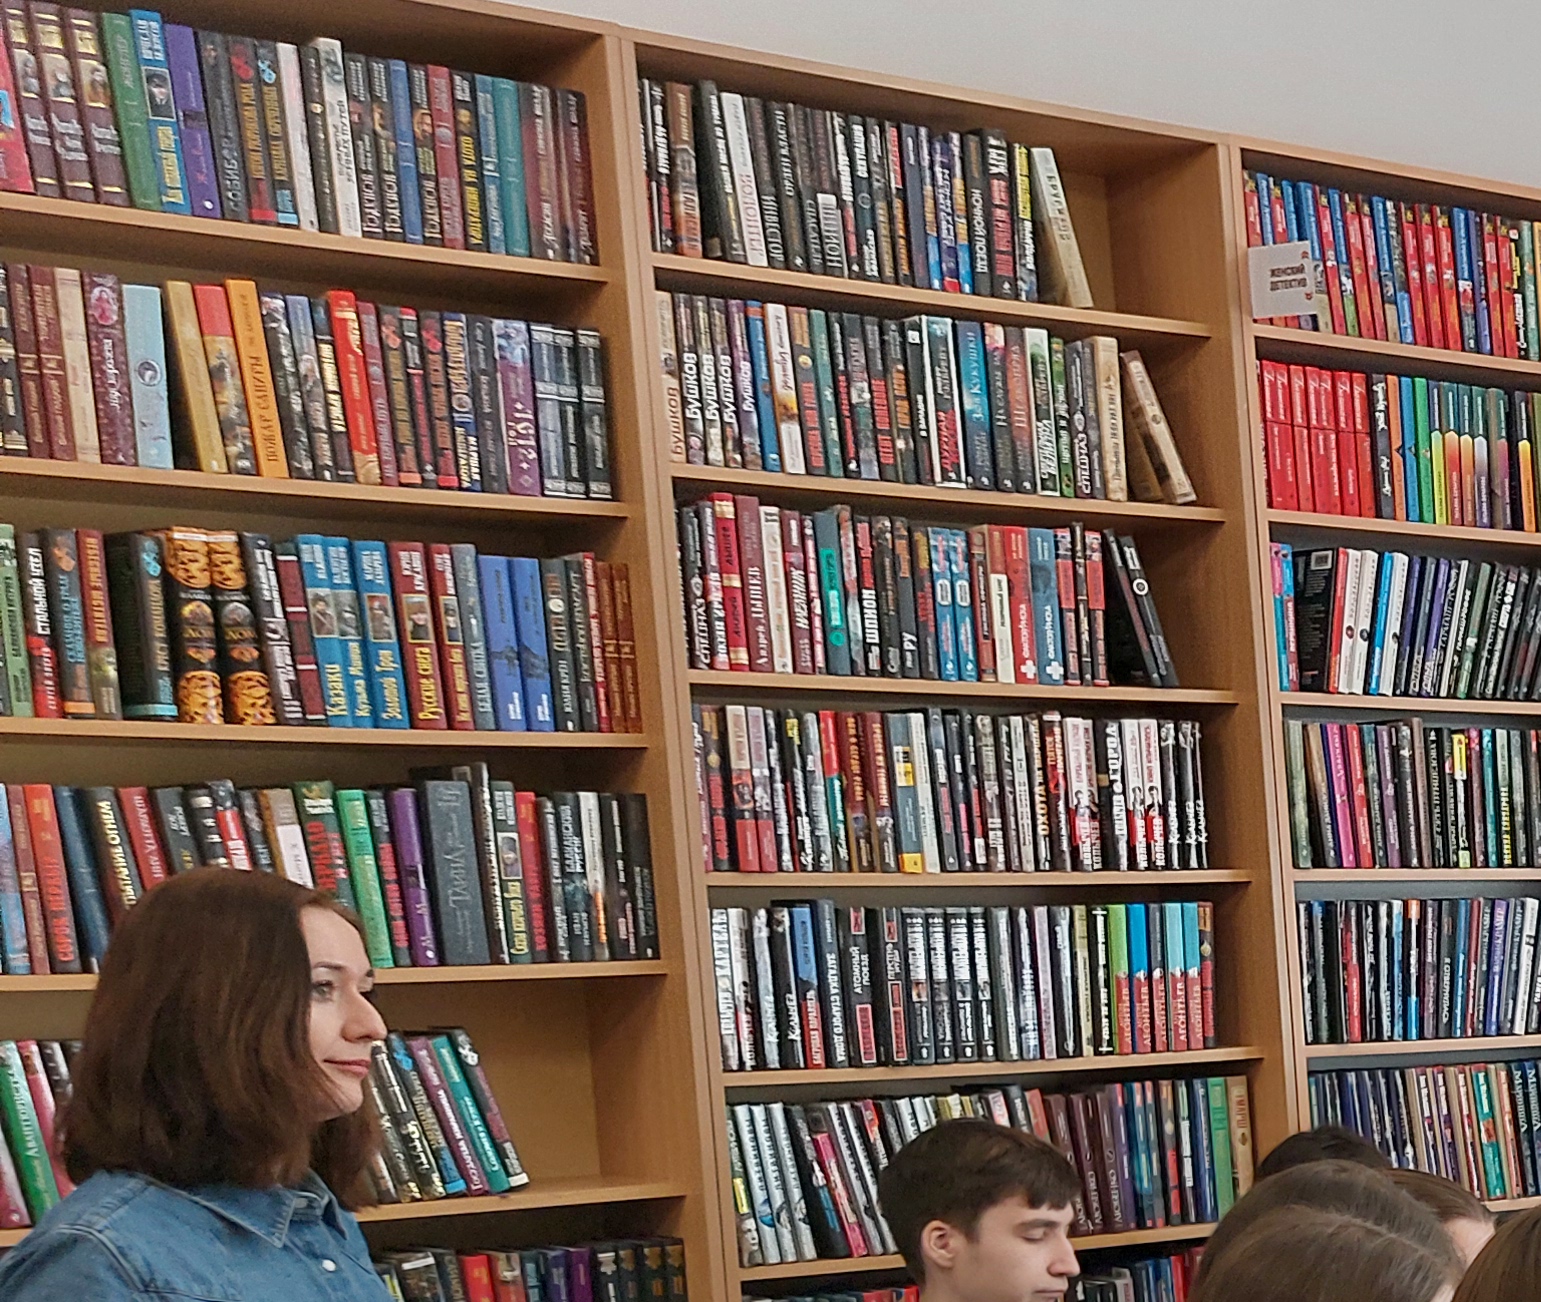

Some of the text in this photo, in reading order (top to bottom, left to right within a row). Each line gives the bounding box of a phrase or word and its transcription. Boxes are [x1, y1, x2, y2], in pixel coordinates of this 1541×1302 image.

[971, 189, 988, 273] НОЧНОЙ ПОЕЗД
[1270, 264, 1306, 279] ЖЕНСКИЙ
[1270, 278, 1308, 292] ДЕТЕКТИВ
[968, 332, 981, 394] Кукушки
[32, 578, 51, 634] СТАЛЬНОЙ
[861, 588, 879, 643] ШПИОН
[324, 664, 348, 717] Казаки
[353, 679, 372, 717] Кузьма
[380, 677, 403, 720] Золотой
[418, 678, 442, 720] Русские
[849, 946, 863, 993] АТОМНЫЙ
